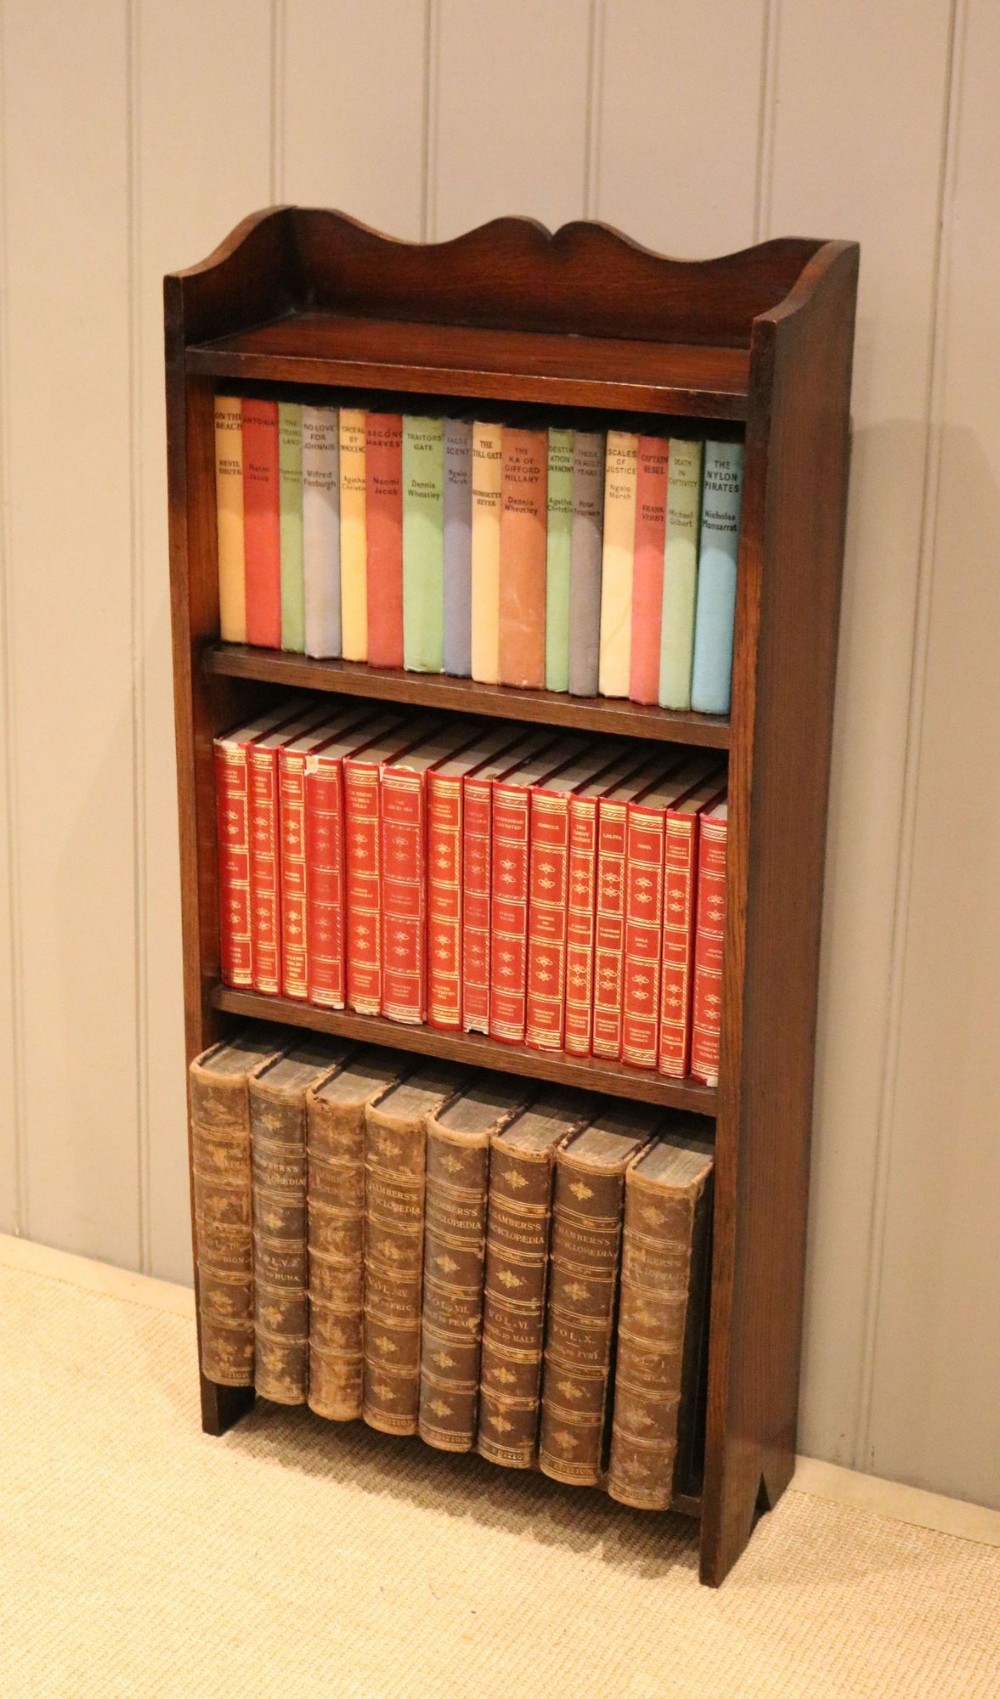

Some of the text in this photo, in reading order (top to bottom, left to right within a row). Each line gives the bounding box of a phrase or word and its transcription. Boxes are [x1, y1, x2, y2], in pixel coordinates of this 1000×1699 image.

[303, 423, 336, 433] NO LOVE
[310, 432, 327, 442] FOR
[303, 442, 336, 452] JOHNNIE
[413, 443, 434, 452] GATE
[479, 440, 493, 449] THE
[514, 447, 528, 455] THE
[607, 448, 637, 458] SCALES
[522, 457, 534, 465] OF
[616, 458, 627, 466] OF
[713, 459, 731, 470] THE
[503, 464, 541, 475] GIFFORD
[606, 465, 637, 475] JUSTICE
[373, 476, 401, 486] Naomi
[707, 470, 738, 482] NYLON
[411, 479, 437, 490] Dennis
[703, 480, 740, 493] PIRATES
[373, 486, 399, 496] Jacob
[407, 487, 441, 501] Wheatley
[507, 495, 535, 507] Dennis
[504, 503, 540, 517] Wheatley
[704, 509, 736, 521] Nicholas
